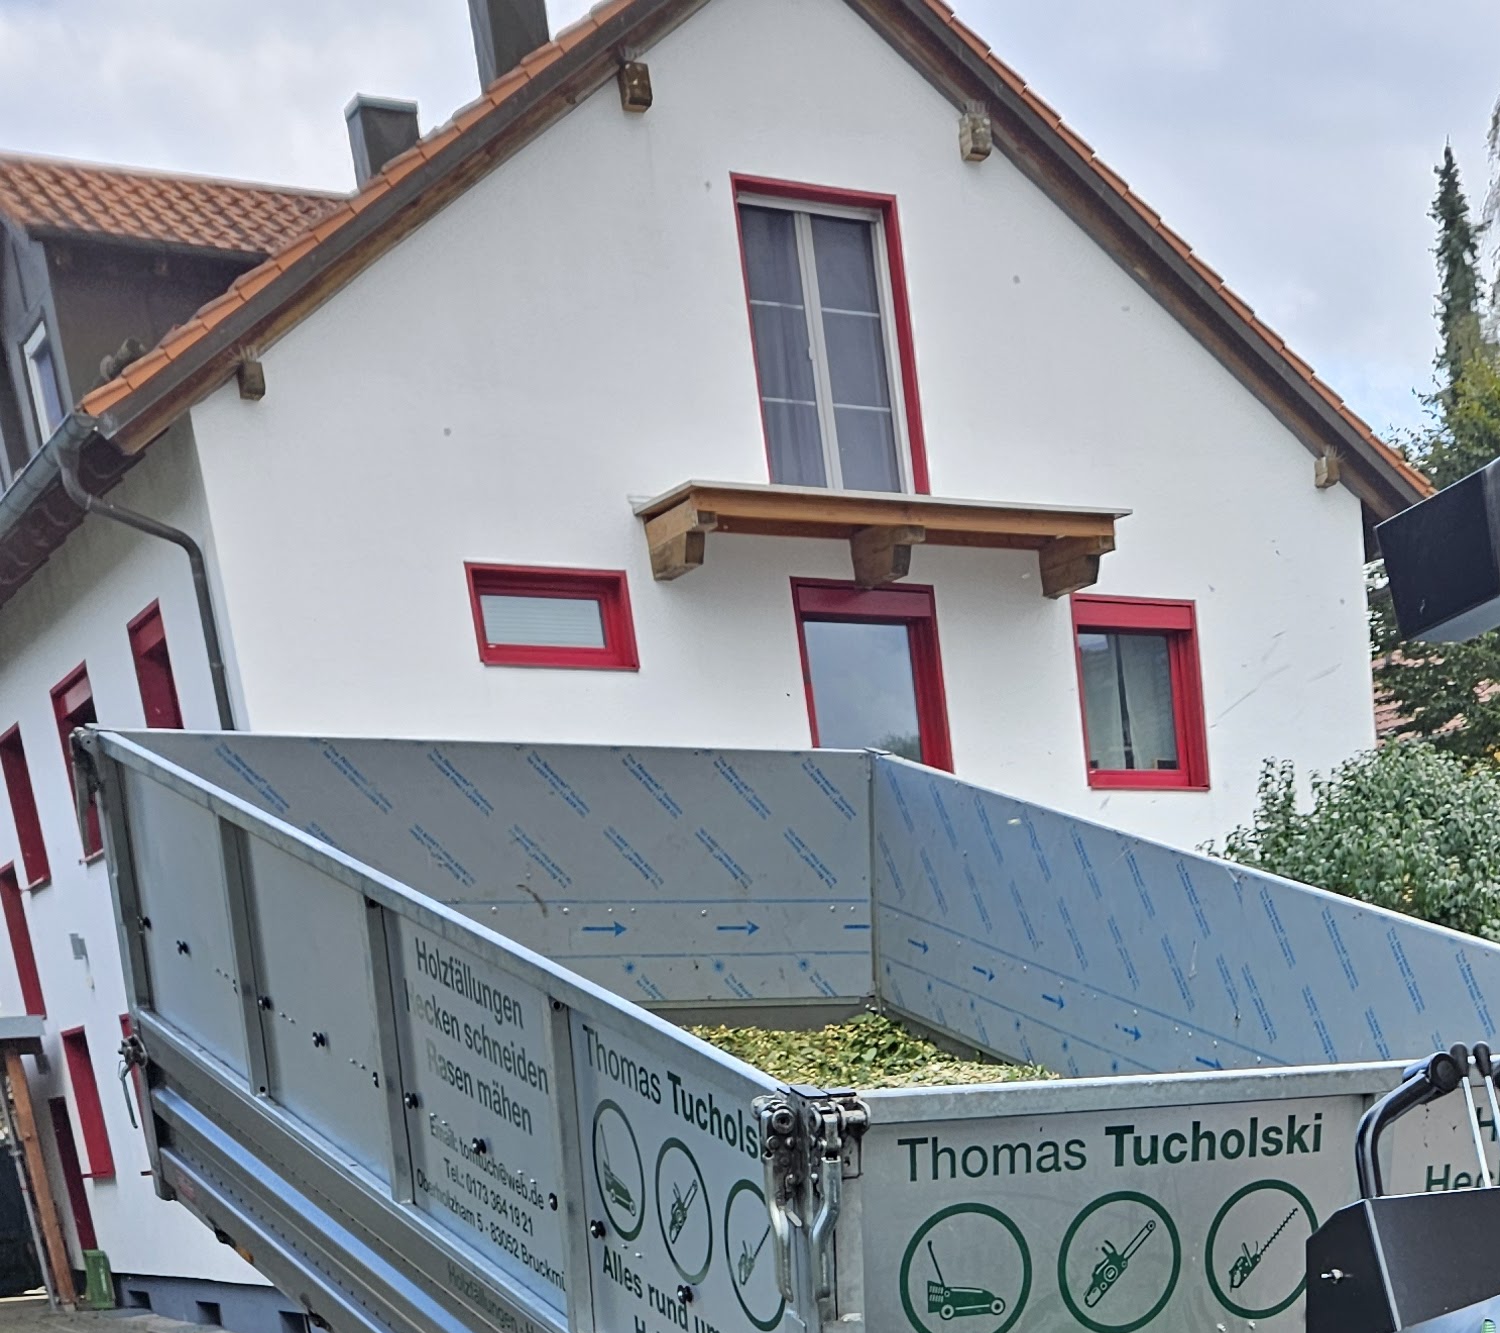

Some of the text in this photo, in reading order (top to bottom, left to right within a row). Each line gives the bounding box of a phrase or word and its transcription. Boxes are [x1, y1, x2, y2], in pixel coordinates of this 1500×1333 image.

[415, 937, 524, 1030] Holzfällungen
[426, 1037, 533, 1136] Rasen mähen
[464, 1023, 549, 1095] schneiden
[582, 1024, 759, 1160] Thomas Tuchols
[897, 1113, 1324, 1182] Thomas Tucholski
[466, 1172, 489, 1205] 0173
[509, 1204, 521, 1229] 19
[521, 1212, 534, 1237] 21
[477, 1213, 484, 1233] 5
[490, 1222, 520, 1259] 83052
[603, 1245, 643, 1299] Alles
[647, 1283, 689, 1332] rund
